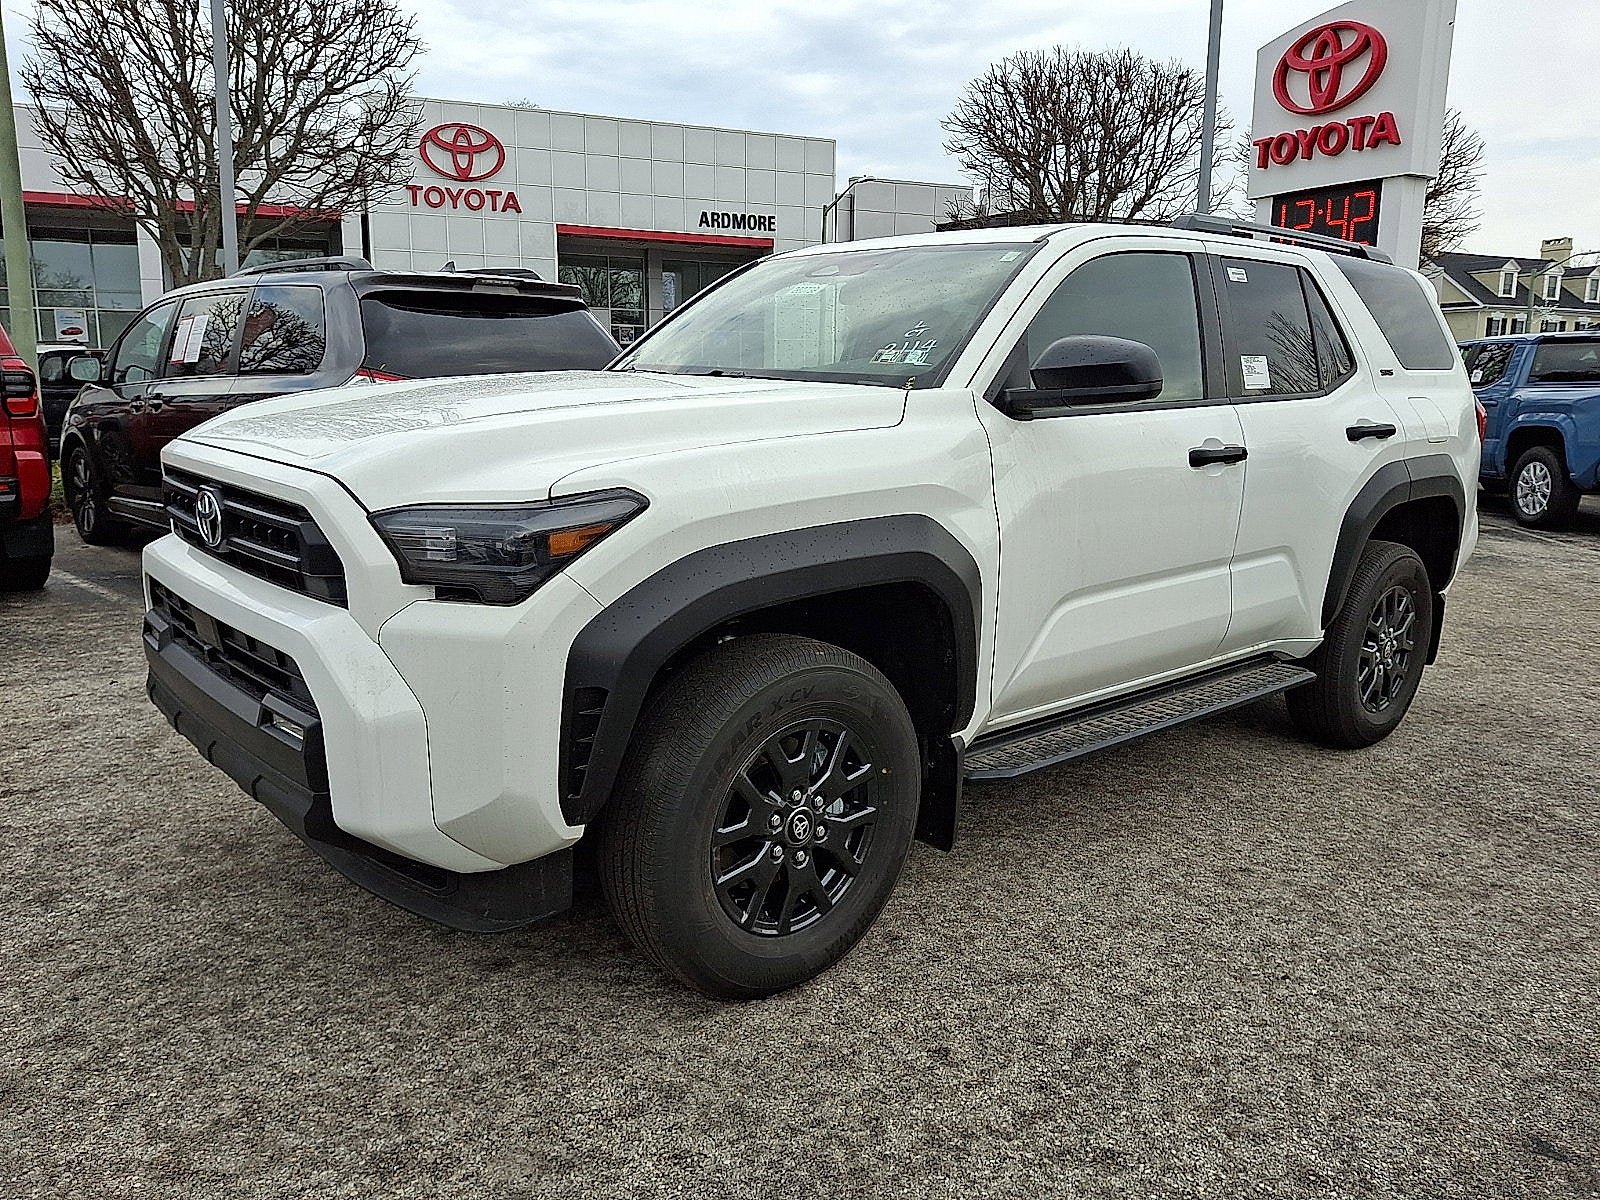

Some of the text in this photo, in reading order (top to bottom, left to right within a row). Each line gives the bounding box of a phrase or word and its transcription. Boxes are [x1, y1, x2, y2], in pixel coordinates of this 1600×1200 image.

[1253, 112, 1401, 169] TOYOTA
[406, 185, 522, 213] TOYOTA
[698, 211, 776, 231] ARDMORE
